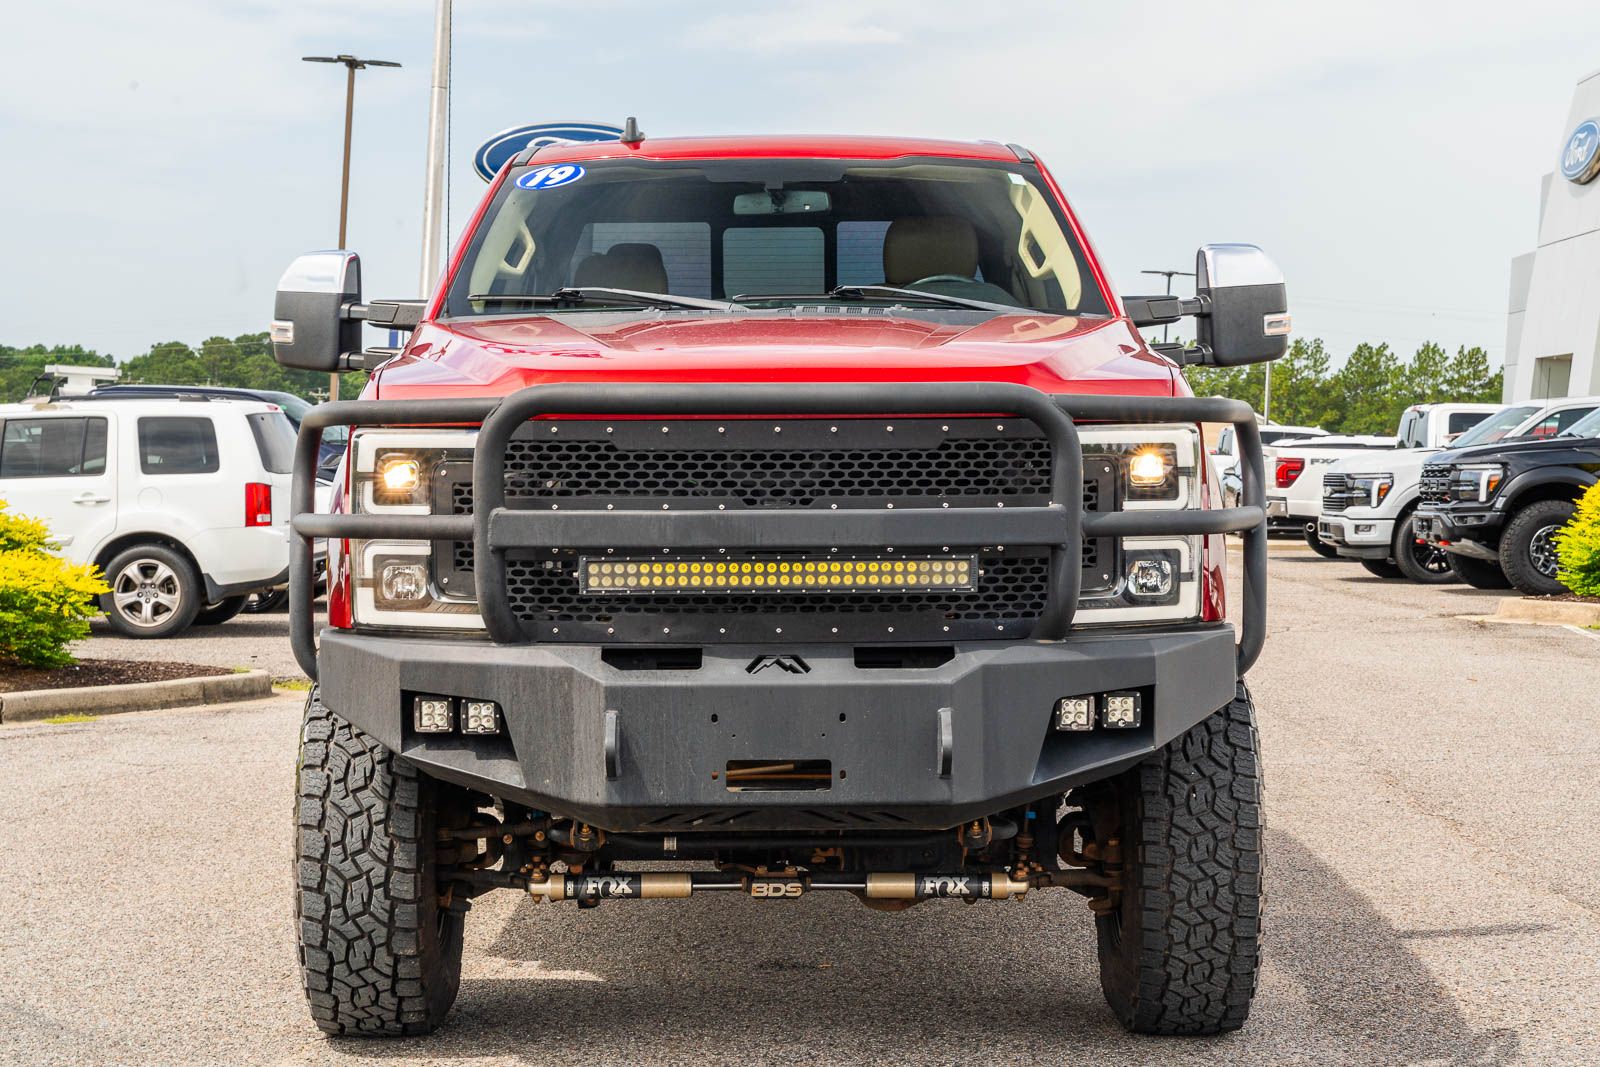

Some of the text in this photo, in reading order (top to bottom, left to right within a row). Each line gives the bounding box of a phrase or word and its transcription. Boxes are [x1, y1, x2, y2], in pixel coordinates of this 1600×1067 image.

[1564, 131, 1592, 169] Ford
[525, 165, 576, 187] 19
[586, 876, 633, 898] FOX
[751, 883, 803, 897] BDS
[923, 876, 970, 898] FOX
